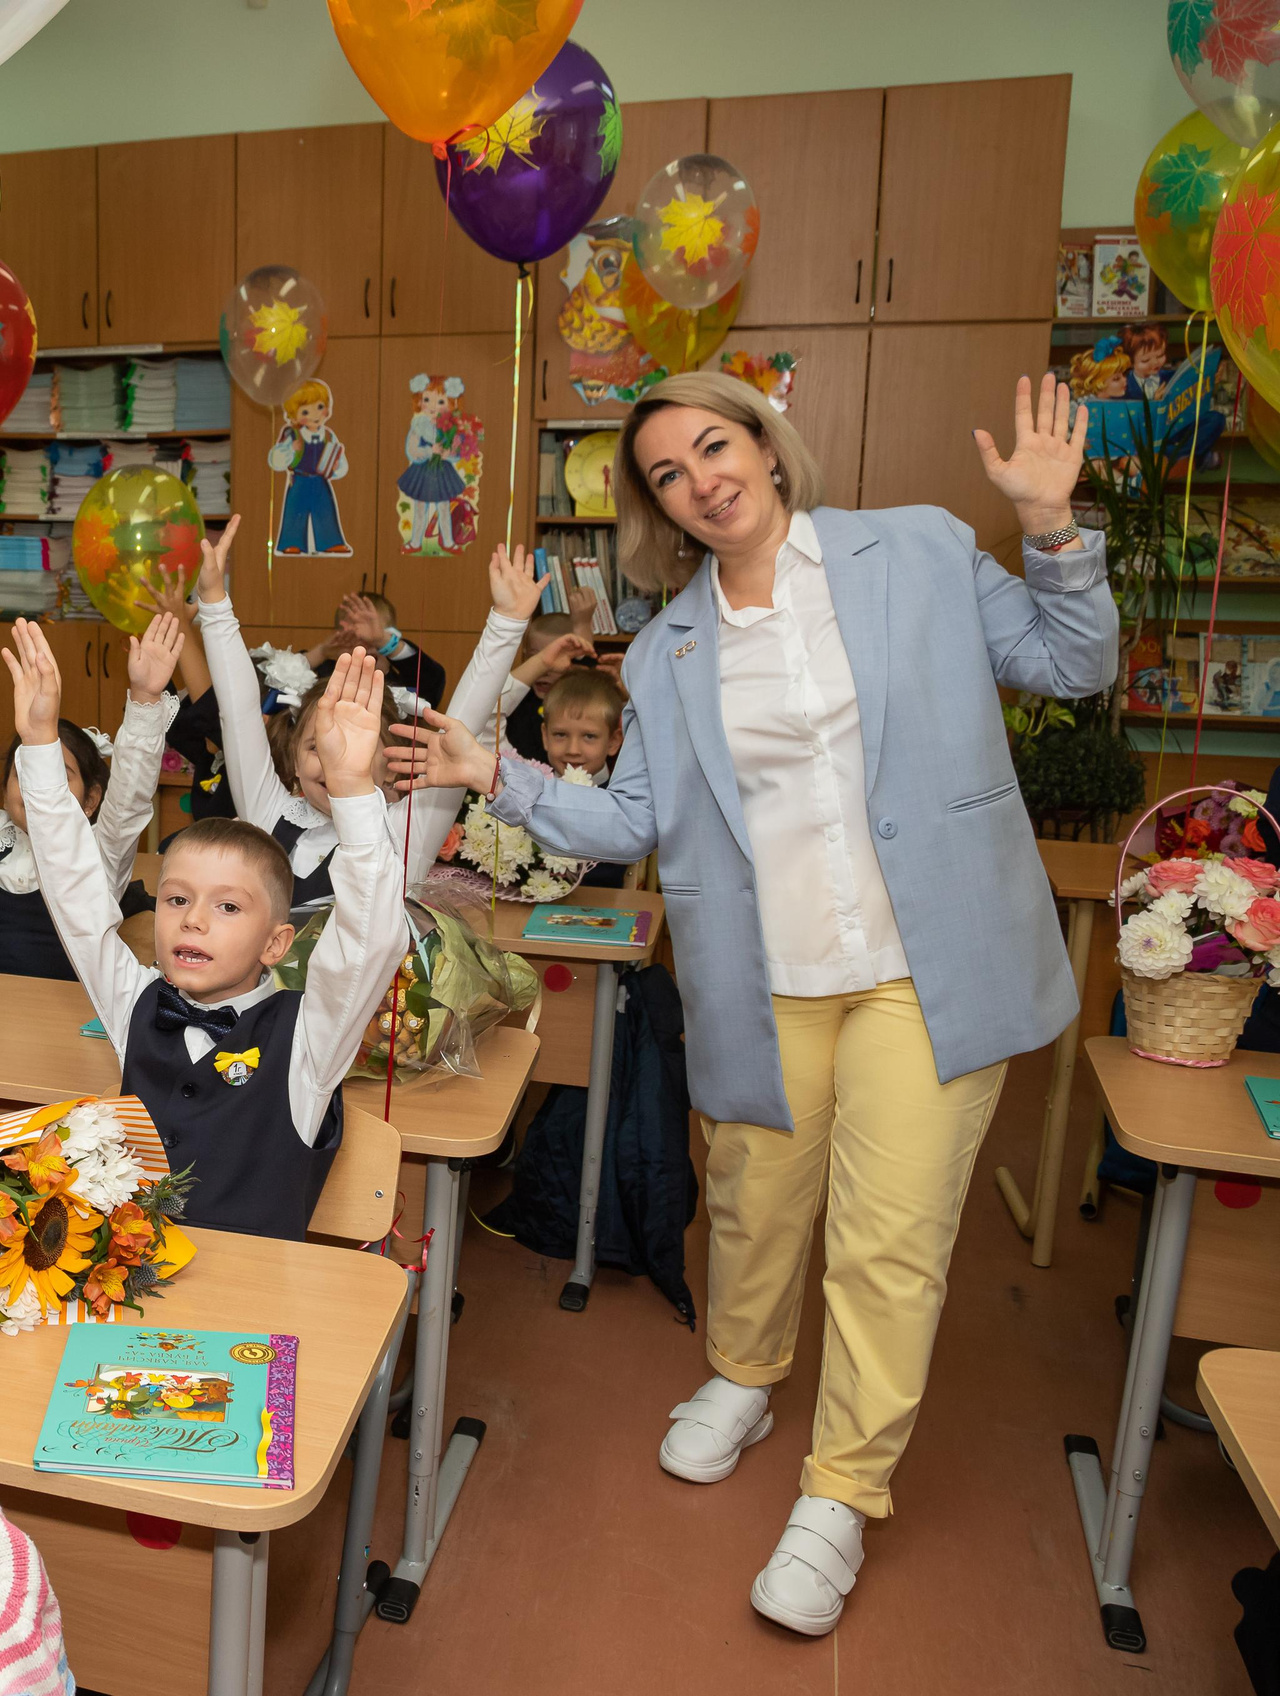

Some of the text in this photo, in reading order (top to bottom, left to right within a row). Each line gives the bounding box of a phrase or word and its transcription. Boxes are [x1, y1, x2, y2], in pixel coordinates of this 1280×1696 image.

[1167, 376, 1211, 420] АЗБУА
[118, 1355, 178, 1365] КЛЯКСИЧ
[150, 1351, 189, 1360] БУКВА
